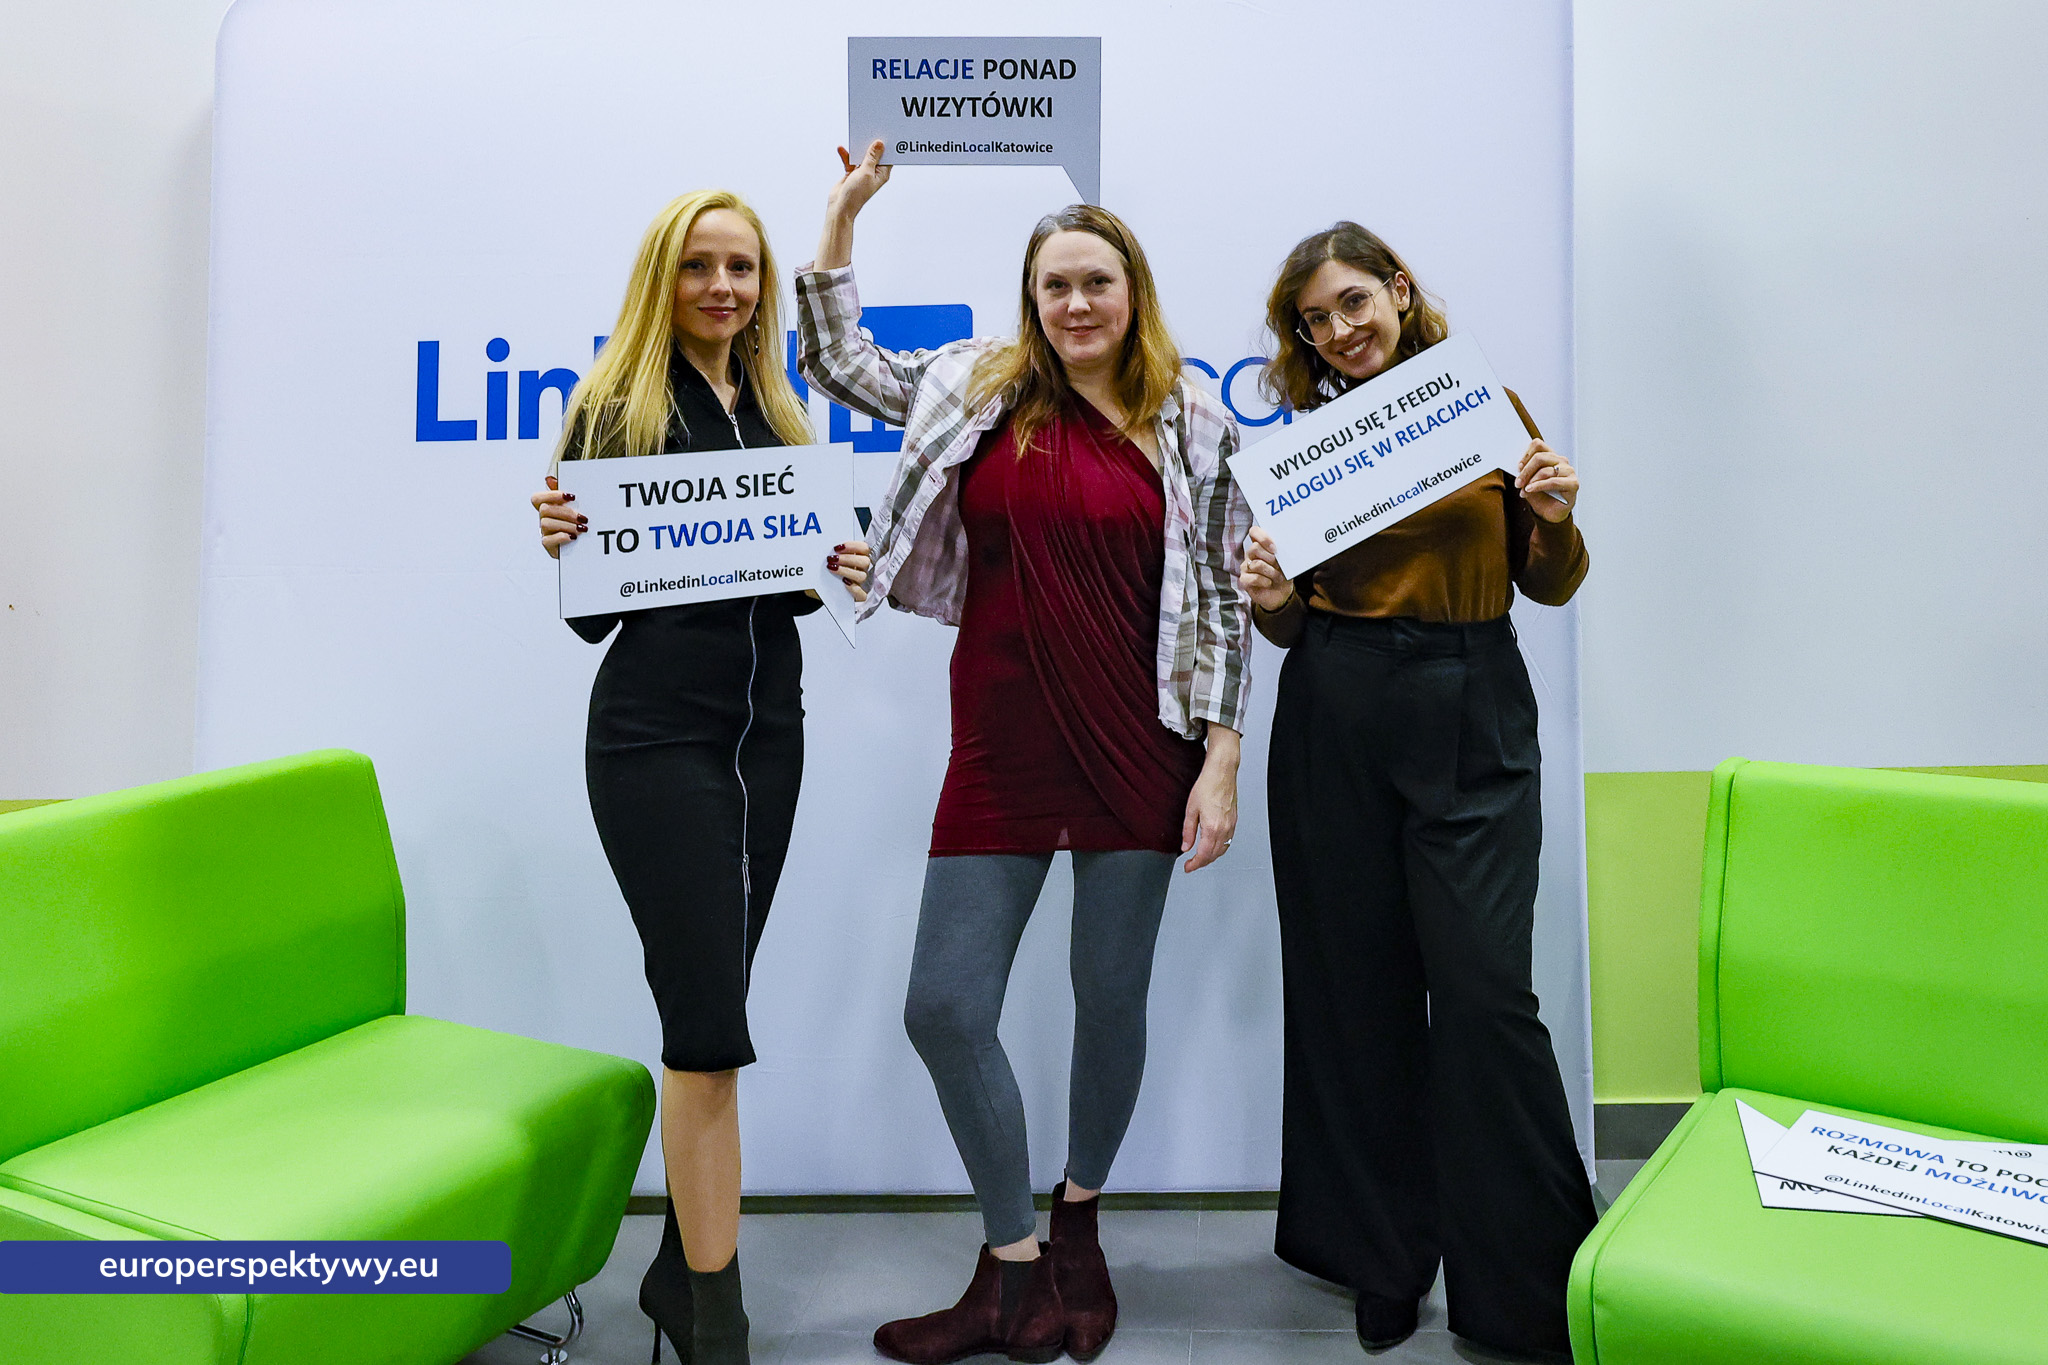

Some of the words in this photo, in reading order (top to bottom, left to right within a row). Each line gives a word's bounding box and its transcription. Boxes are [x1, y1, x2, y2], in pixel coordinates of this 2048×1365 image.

[873, 59, 974, 79] RELACJE
[984, 59, 1076, 80] PONAD
[901, 91, 1052, 117] WIZYTÓWKI
[896, 141, 1053, 153] @LinkedinLocalKatowice
[1270, 427, 1353, 480] WYLOGUJ
[1355, 411, 1385, 435] SIĘ
[1383, 404, 1397, 420] Z
[1398, 373, 1459, 412] FEEDU,
[1266, 465, 1342, 516] ZALOGUJ
[1344, 450, 1374, 474] SIĘ
[1372, 437, 1392, 457] W
[1395, 386, 1491, 446] RELACJACH
[619, 477, 727, 507] TWOJA
[736, 465, 794, 498] SIEĆ
[1325, 454, 1481, 543] @LinkedinLocalKatowice
[597, 528, 639, 555] TO
[649, 518, 754, 550] TWOJA
[764, 512, 822, 539] SIŁA
[620, 565, 803, 597] @LinkedinLocalKatowice
[1811, 1127, 1944, 1163] ROZMOWA
[1956, 1159, 1988, 1172] TO
[1828, 1145, 1917, 1171] KAŻDEJ
